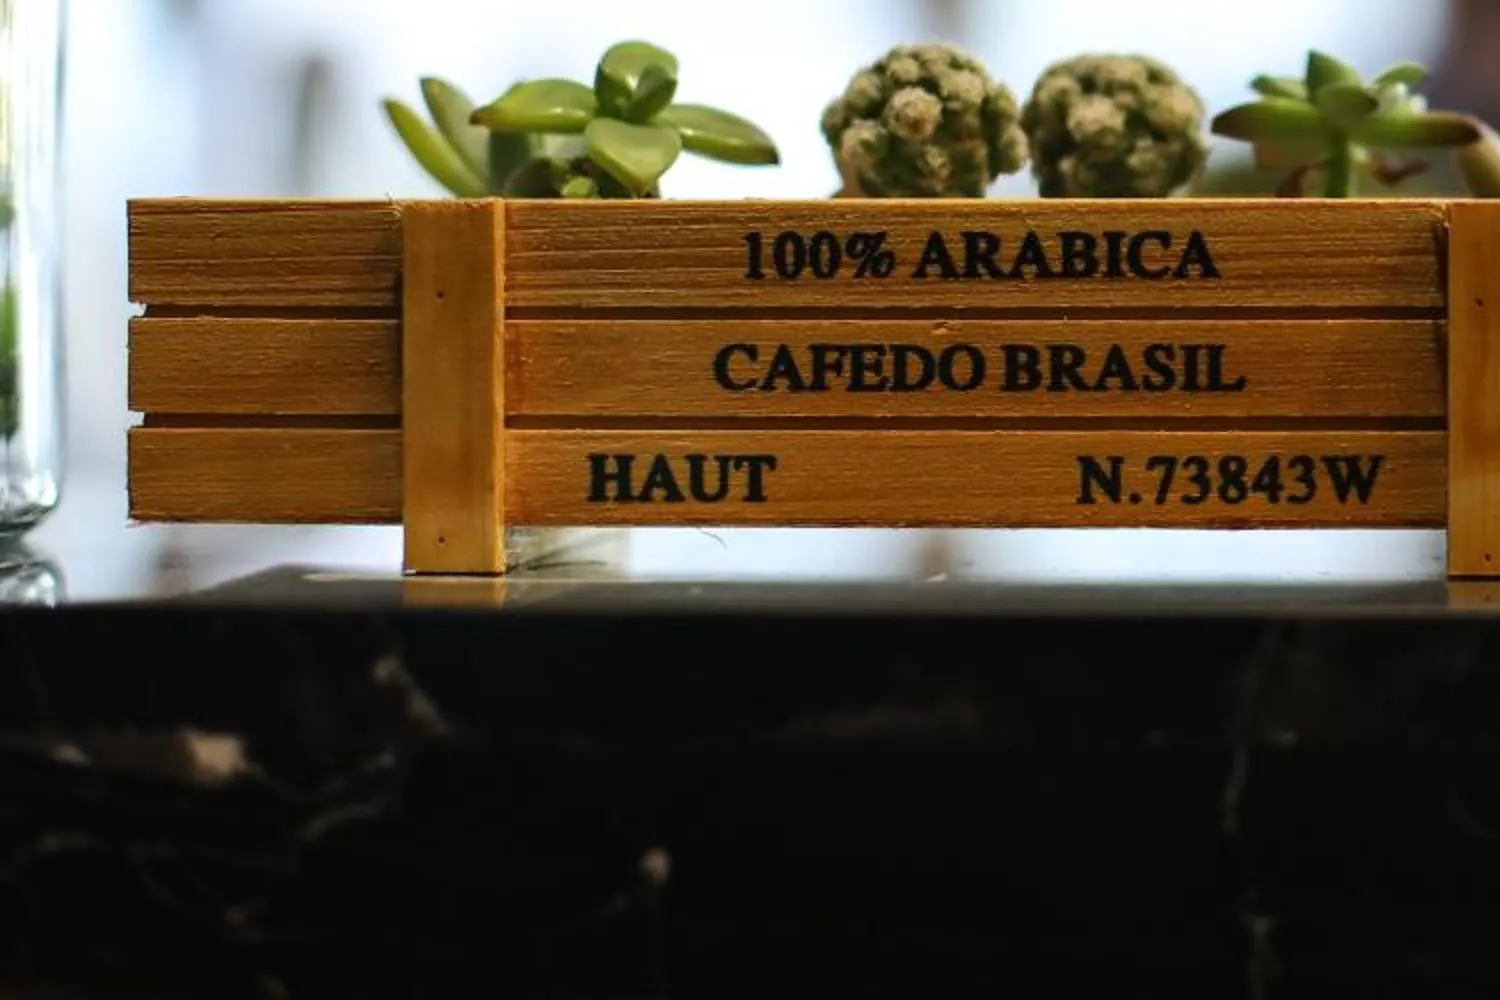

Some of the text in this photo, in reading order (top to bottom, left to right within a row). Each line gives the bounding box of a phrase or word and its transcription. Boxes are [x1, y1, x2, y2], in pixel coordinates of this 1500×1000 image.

[744, 230, 1220, 281] 100% ARABICA
[1001, 343, 1246, 394] BRASIL
[587, 453, 777, 504] HAUT
[1077, 454, 1383, 506] N.73843W
